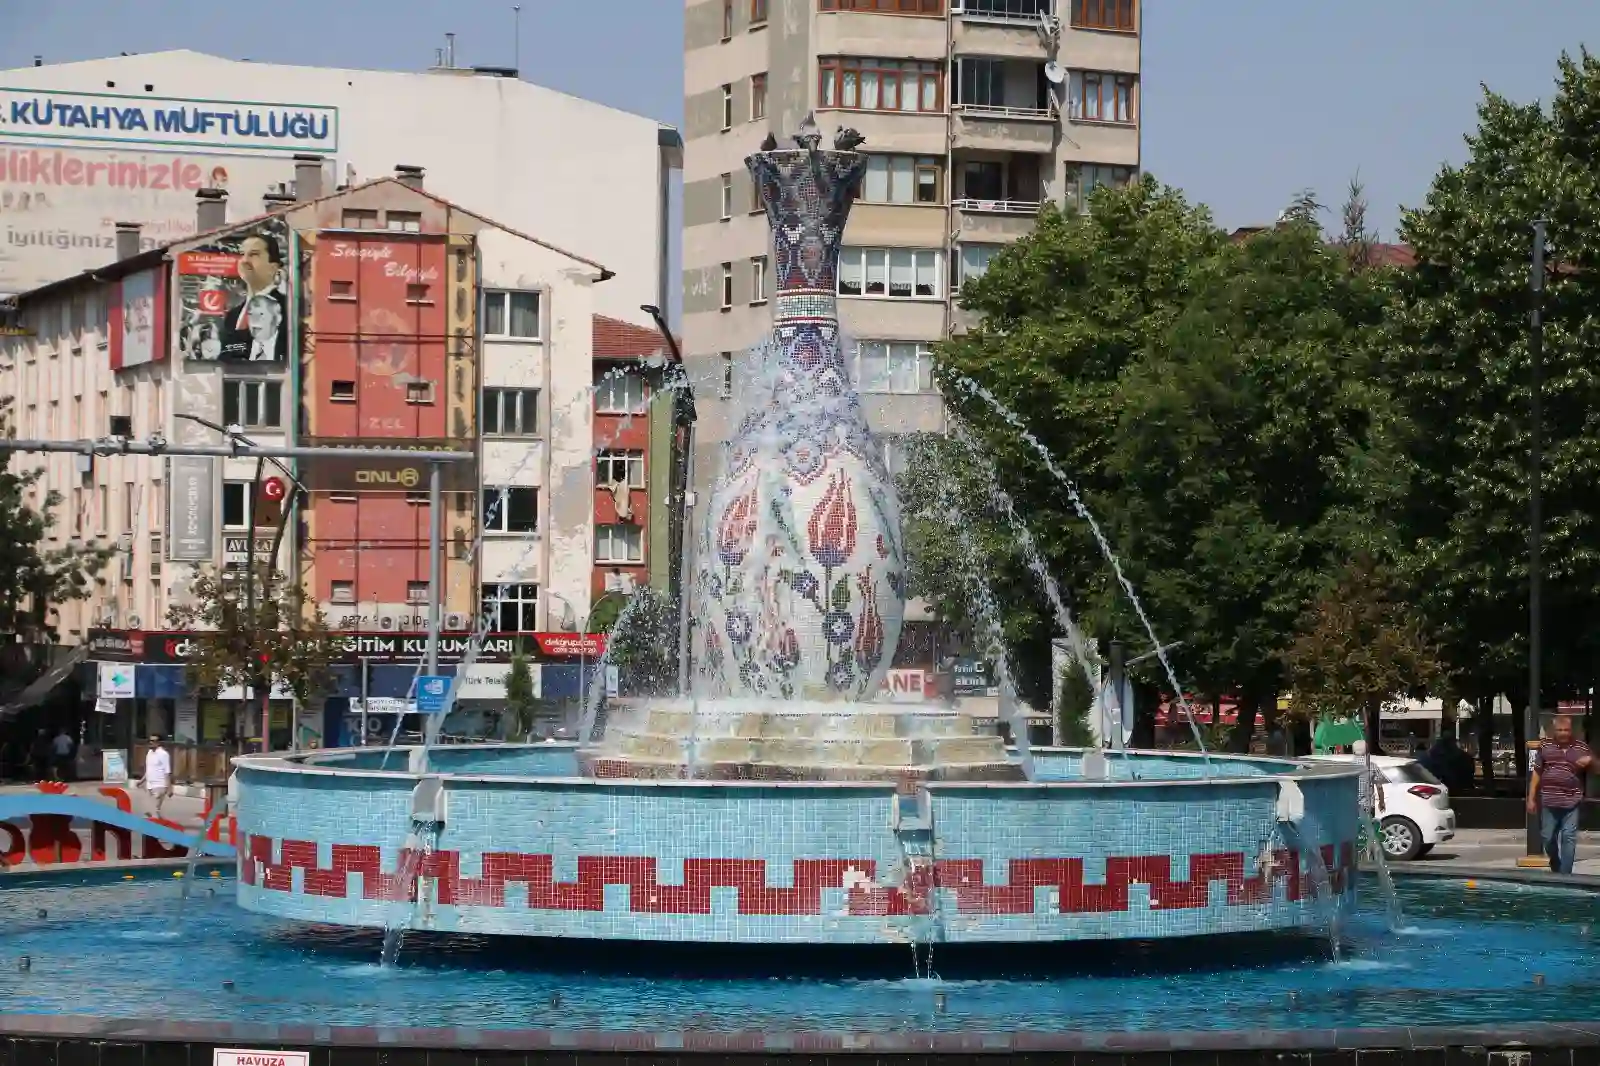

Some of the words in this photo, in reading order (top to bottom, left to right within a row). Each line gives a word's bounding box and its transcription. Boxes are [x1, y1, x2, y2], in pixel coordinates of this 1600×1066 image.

[11, 98, 148, 131] KÜTAHYA
[154, 107, 328, 140] MÜFTÜLÜĞÜ
[355, 468, 419, 487] ONUR
[236, 1056, 285, 1066] HAVUZA
